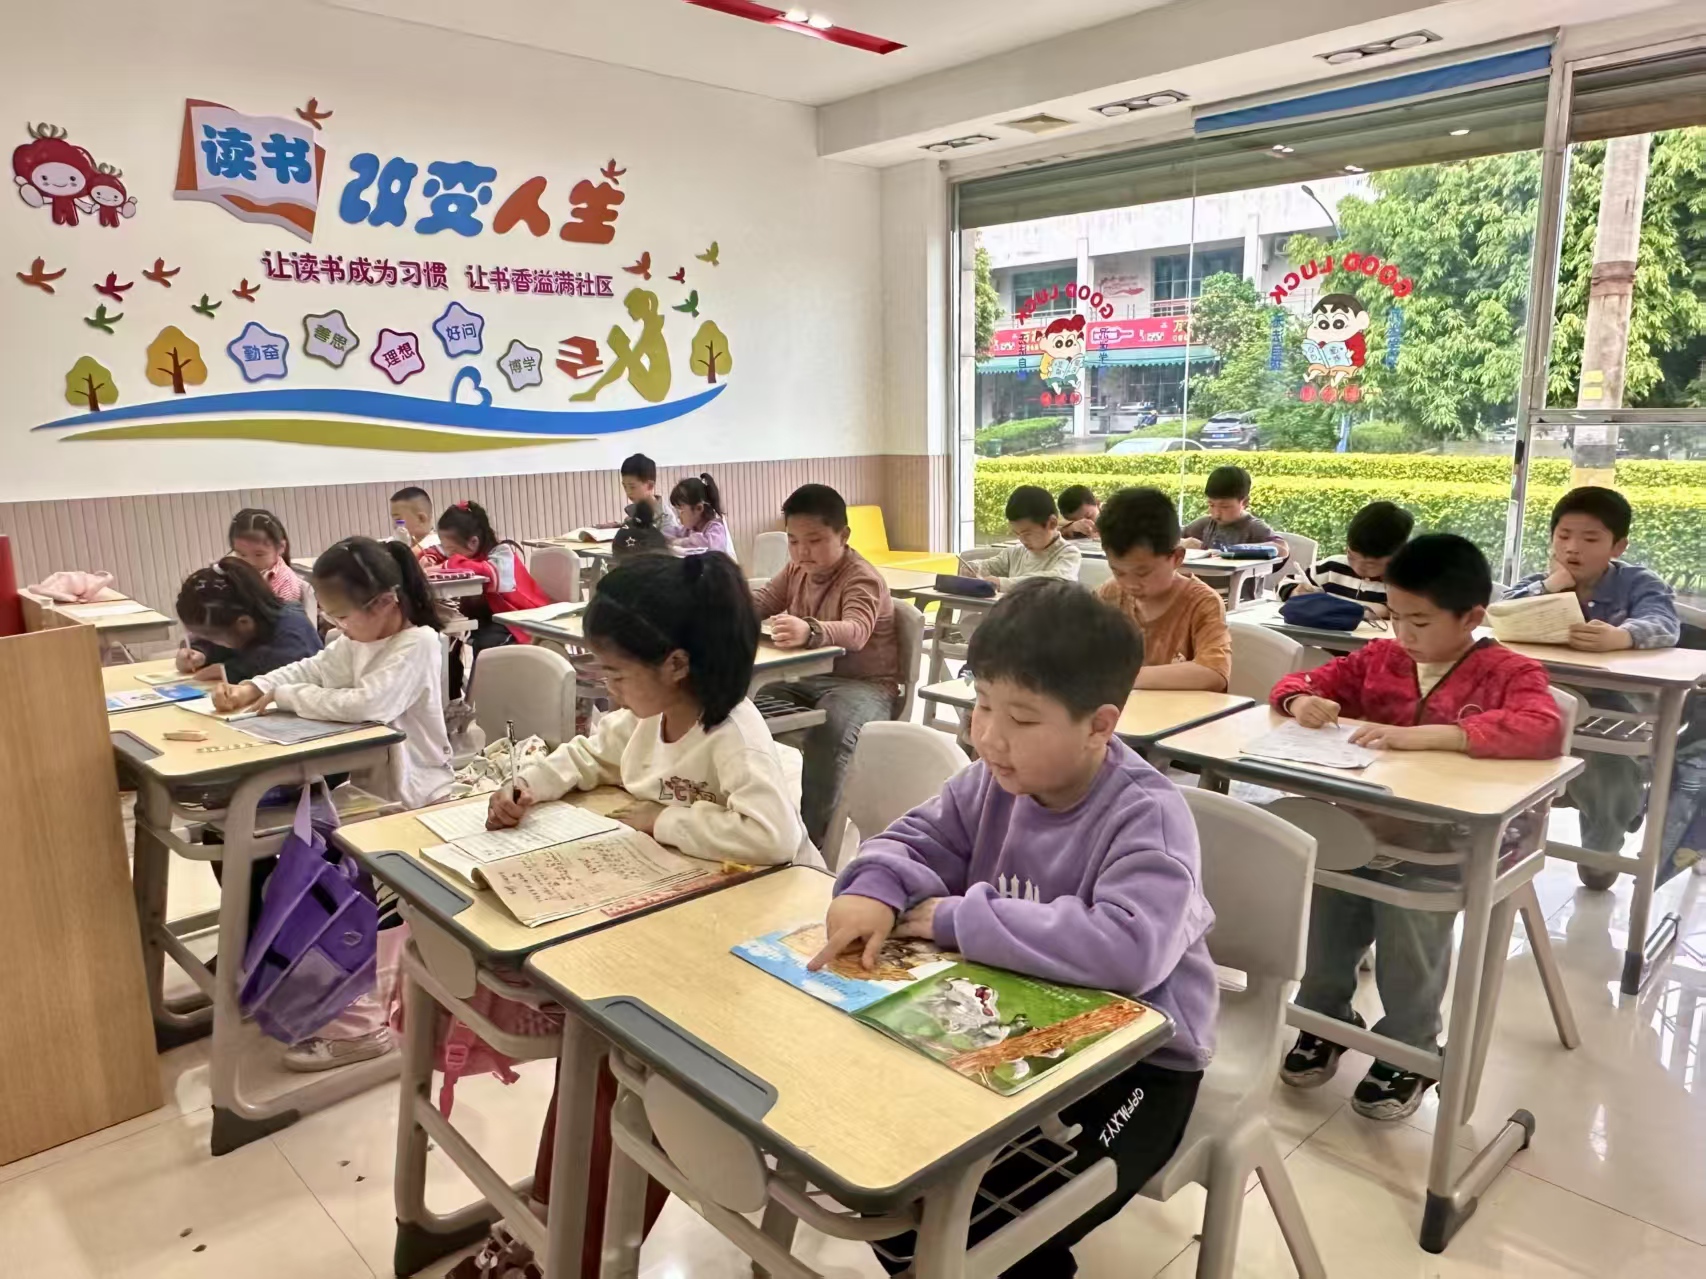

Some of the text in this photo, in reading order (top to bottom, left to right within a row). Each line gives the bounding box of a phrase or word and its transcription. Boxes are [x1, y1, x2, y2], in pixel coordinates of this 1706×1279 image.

[200, 124, 312, 184] 读书
[339, 152, 626, 245] 改变人生
[261, 250, 615, 298] 让读书成为习惯 让书香溢满社区
[313, 324, 349, 352] 善思
[445, 322, 478, 342] 好问
[242, 344, 280, 362] 勤奋
[381, 341, 416, 368] 理想
[508, 355, 537, 375] 博学
